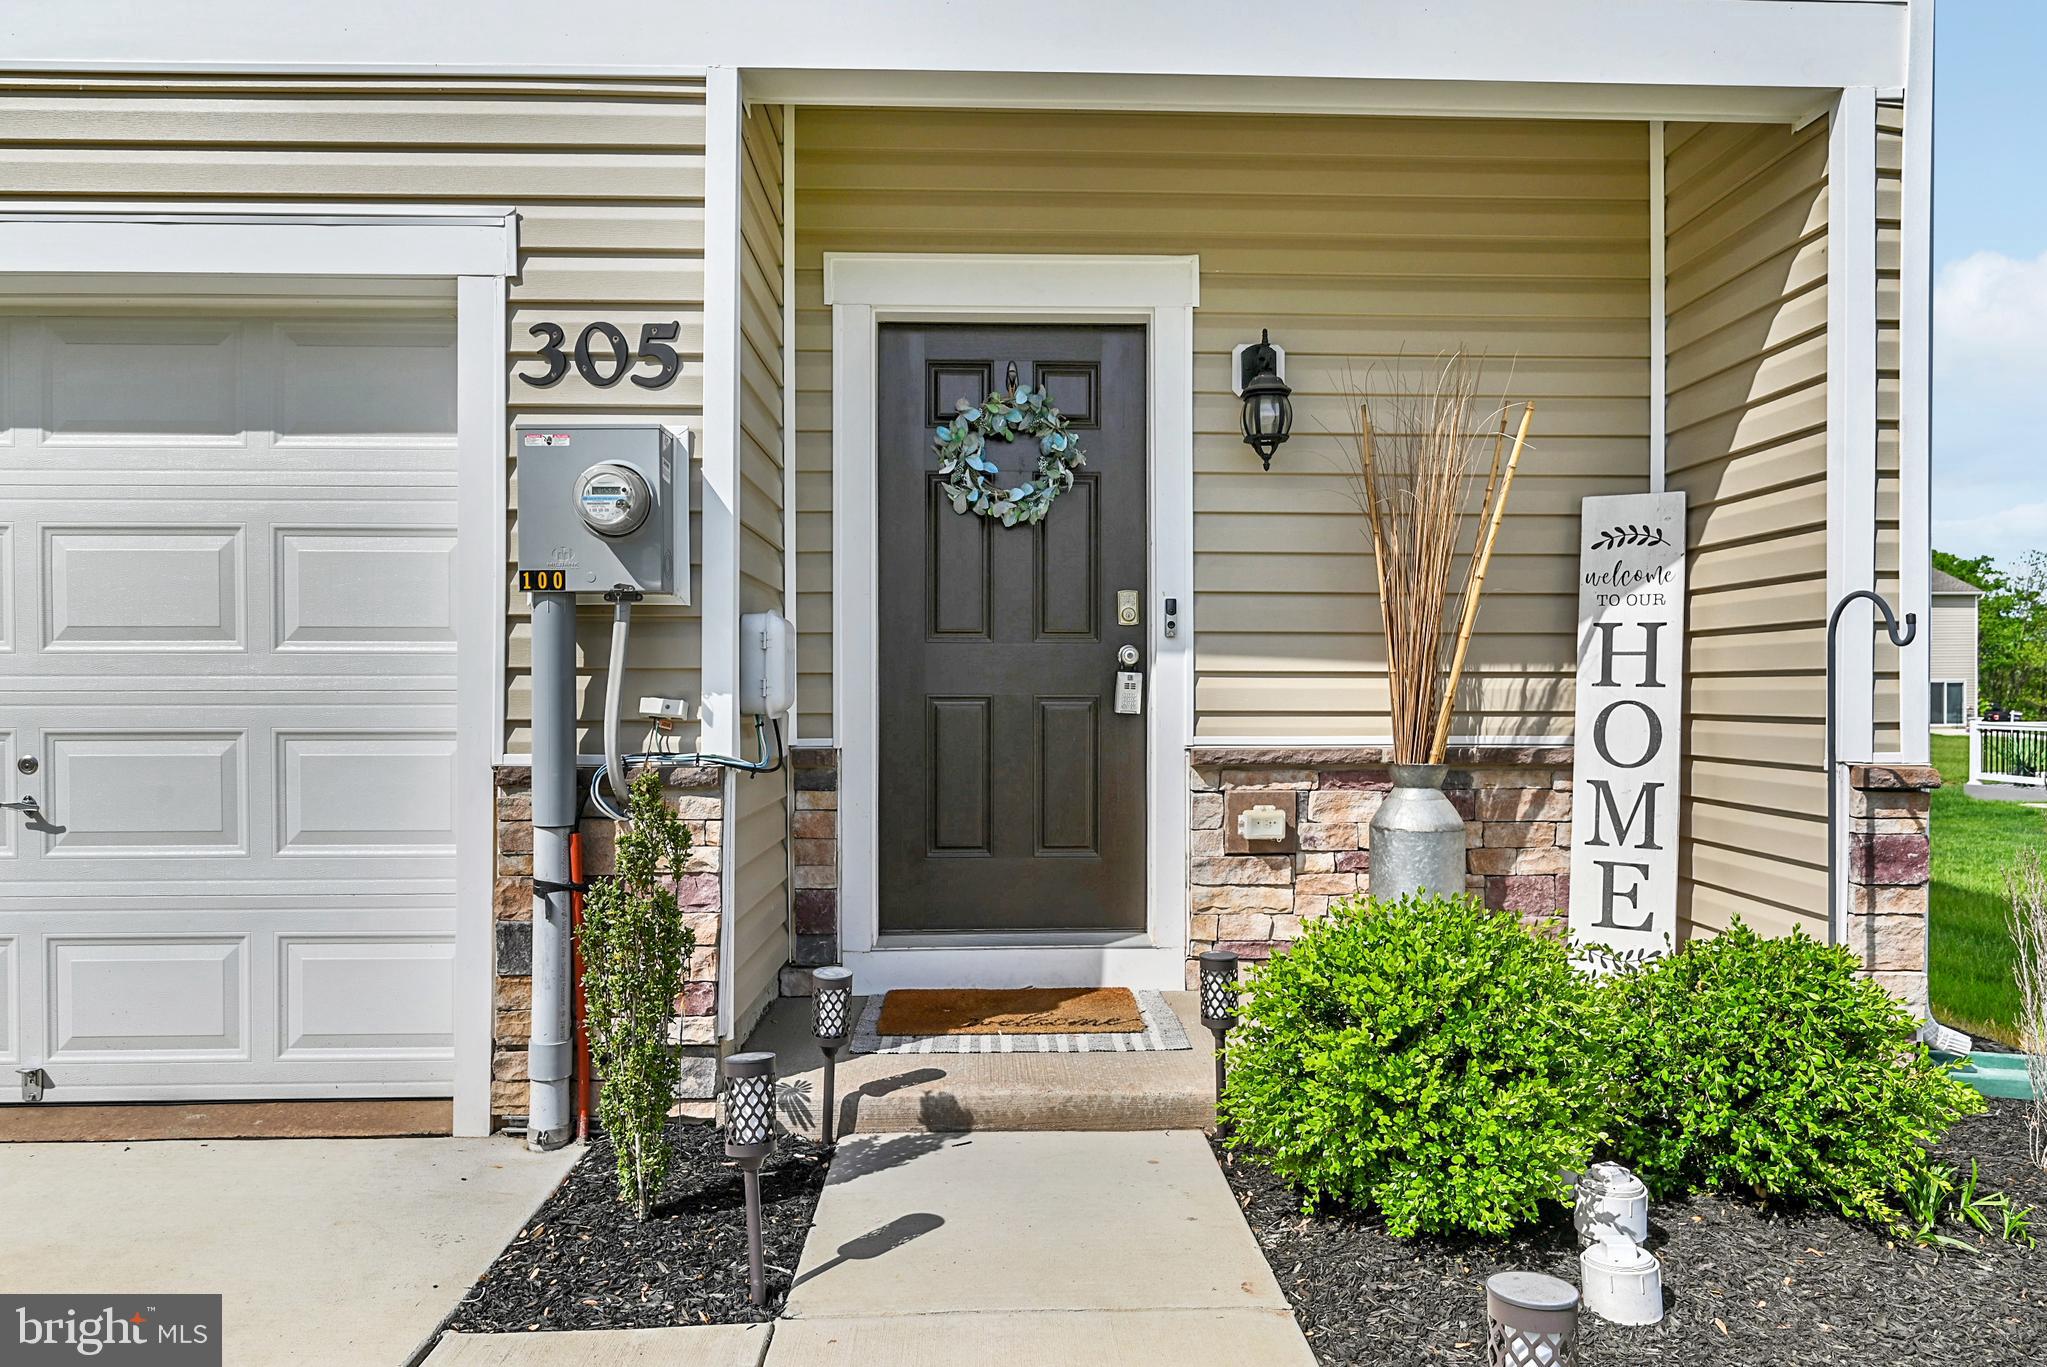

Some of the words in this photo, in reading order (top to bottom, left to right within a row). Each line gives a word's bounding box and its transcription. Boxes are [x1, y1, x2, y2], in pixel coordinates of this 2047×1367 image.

[518, 320, 681, 389] 305
[523, 571, 563, 590] 100
[1585, 559, 1677, 588] welcome
[1596, 593, 1621, 607] TO
[1626, 593, 1667, 606] OUR
[1584, 621, 1668, 933] HOME
